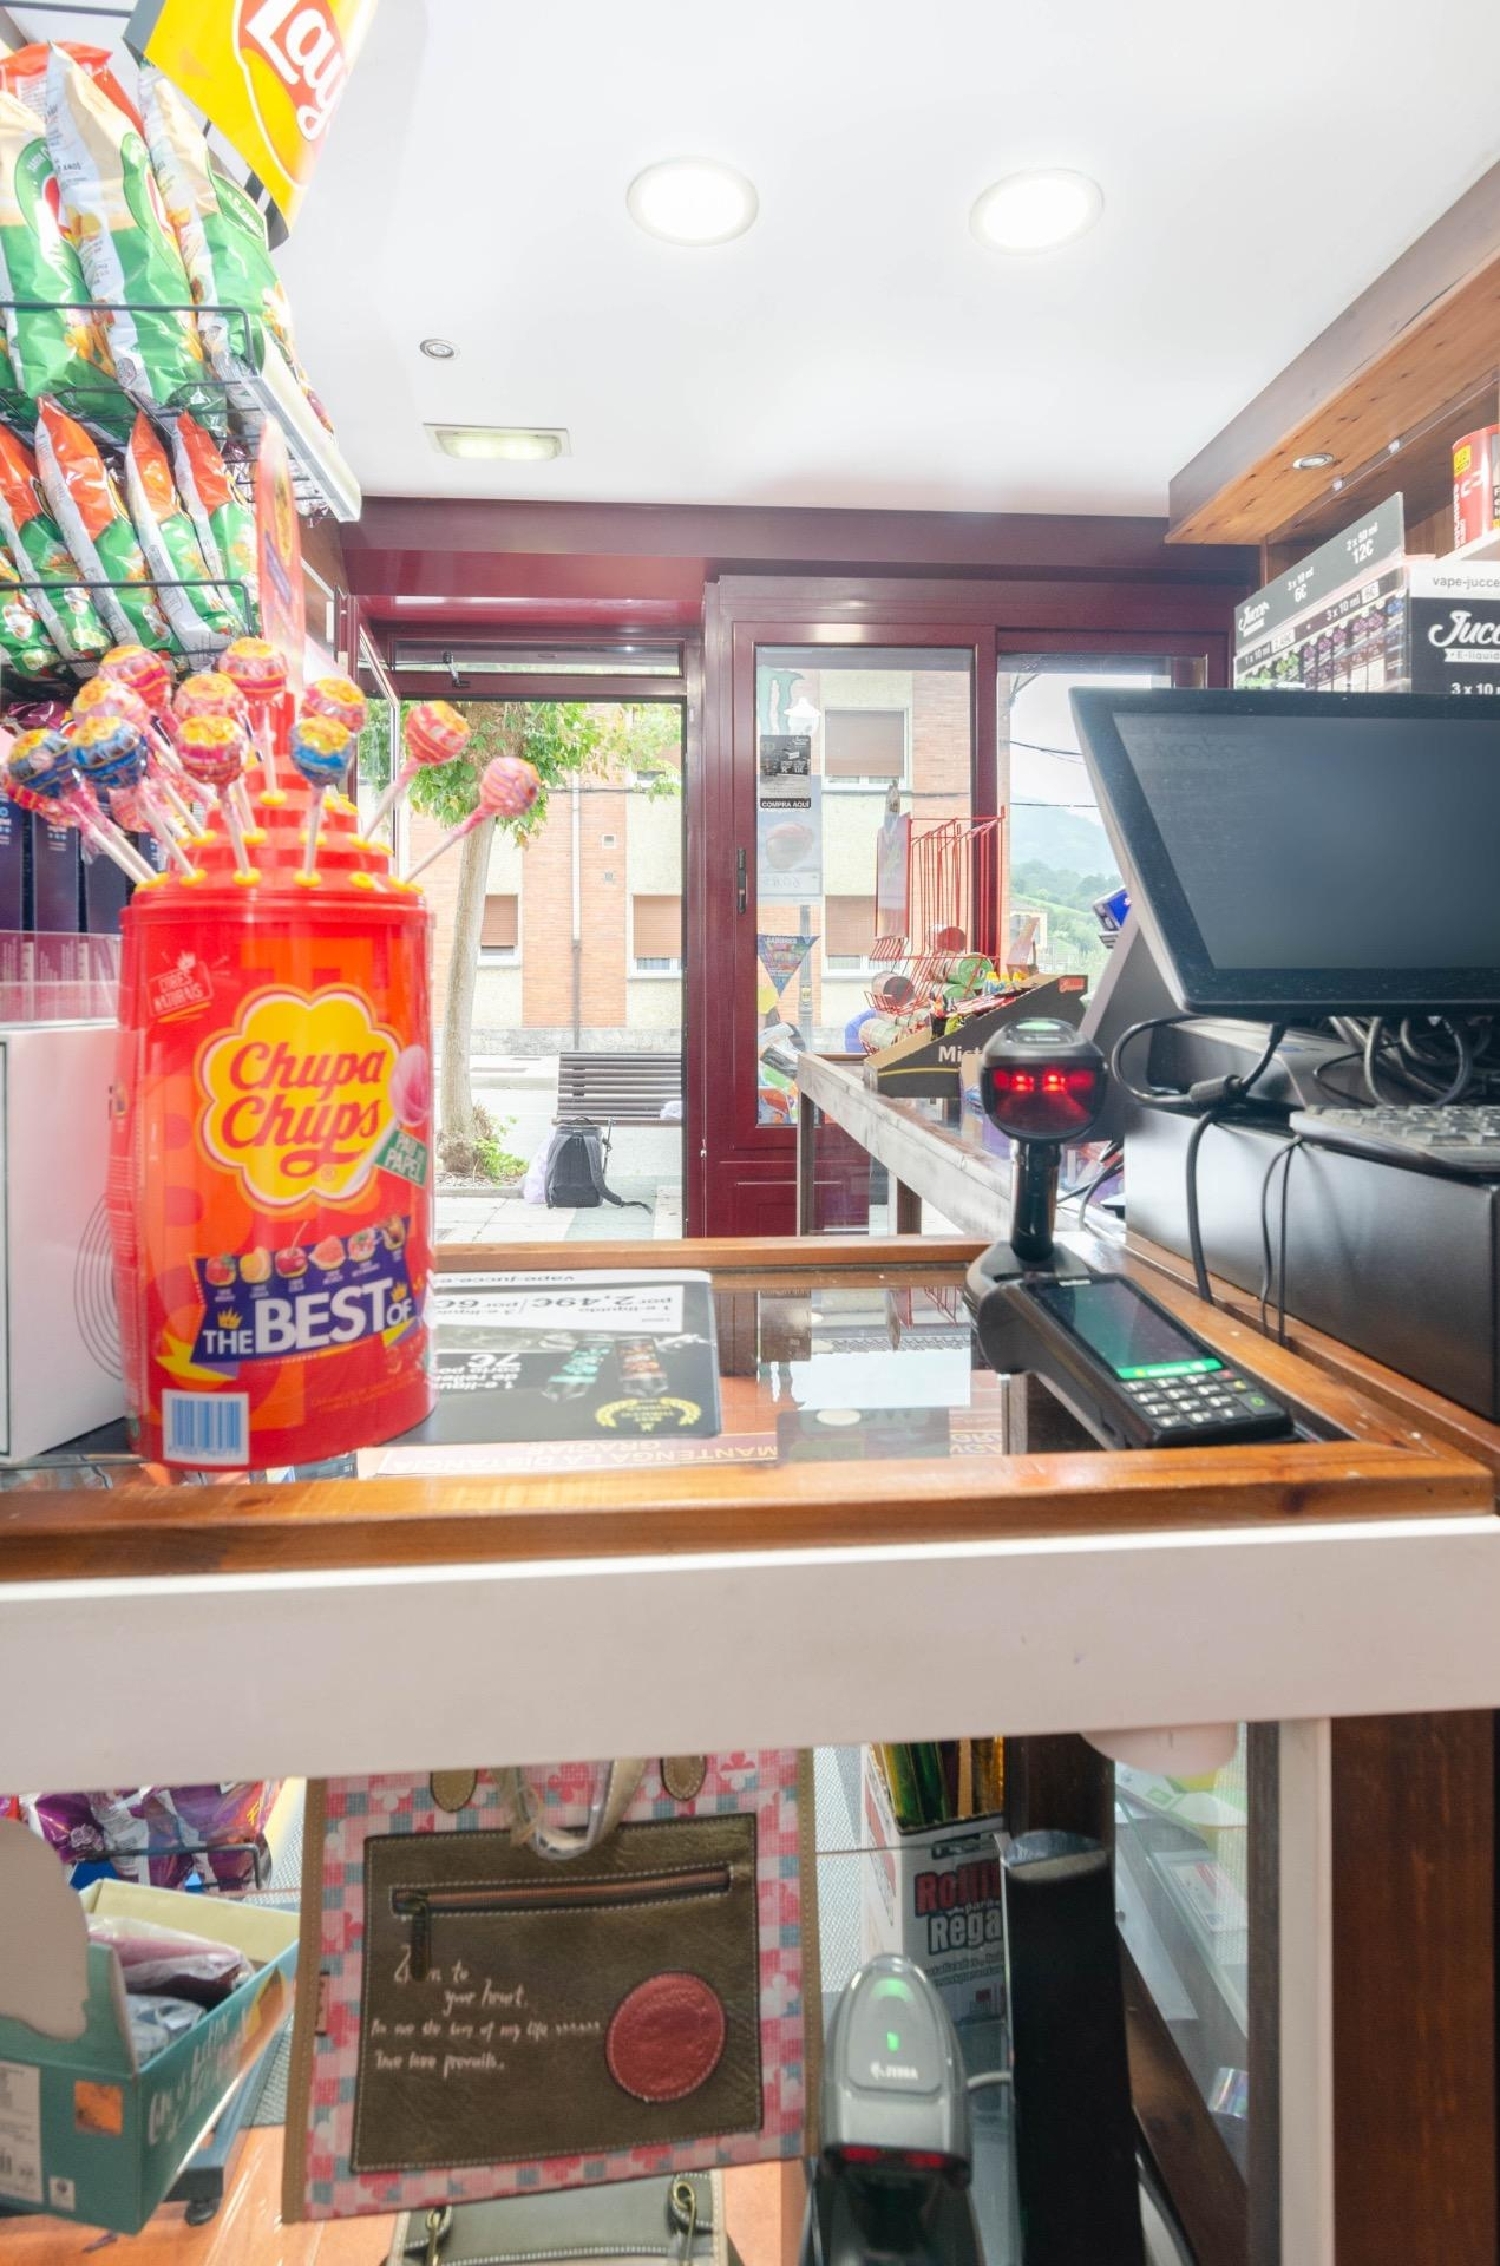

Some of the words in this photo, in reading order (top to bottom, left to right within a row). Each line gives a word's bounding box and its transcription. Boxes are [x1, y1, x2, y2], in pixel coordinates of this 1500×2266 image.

[1451, 682, 1461, 695] 3
[1464, 685, 1473, 695] x
[1476, 682, 1493, 695] 10
[229, 1041, 387, 1101] Chupa
[221, 1094, 380, 1179] Chups
[202, 1329, 254, 1355] THE
[255, 1278, 393, 1354] BEST
[564, 1454, 603, 1464] LA
[610, 1446, 778, 1463] MANTENGA
